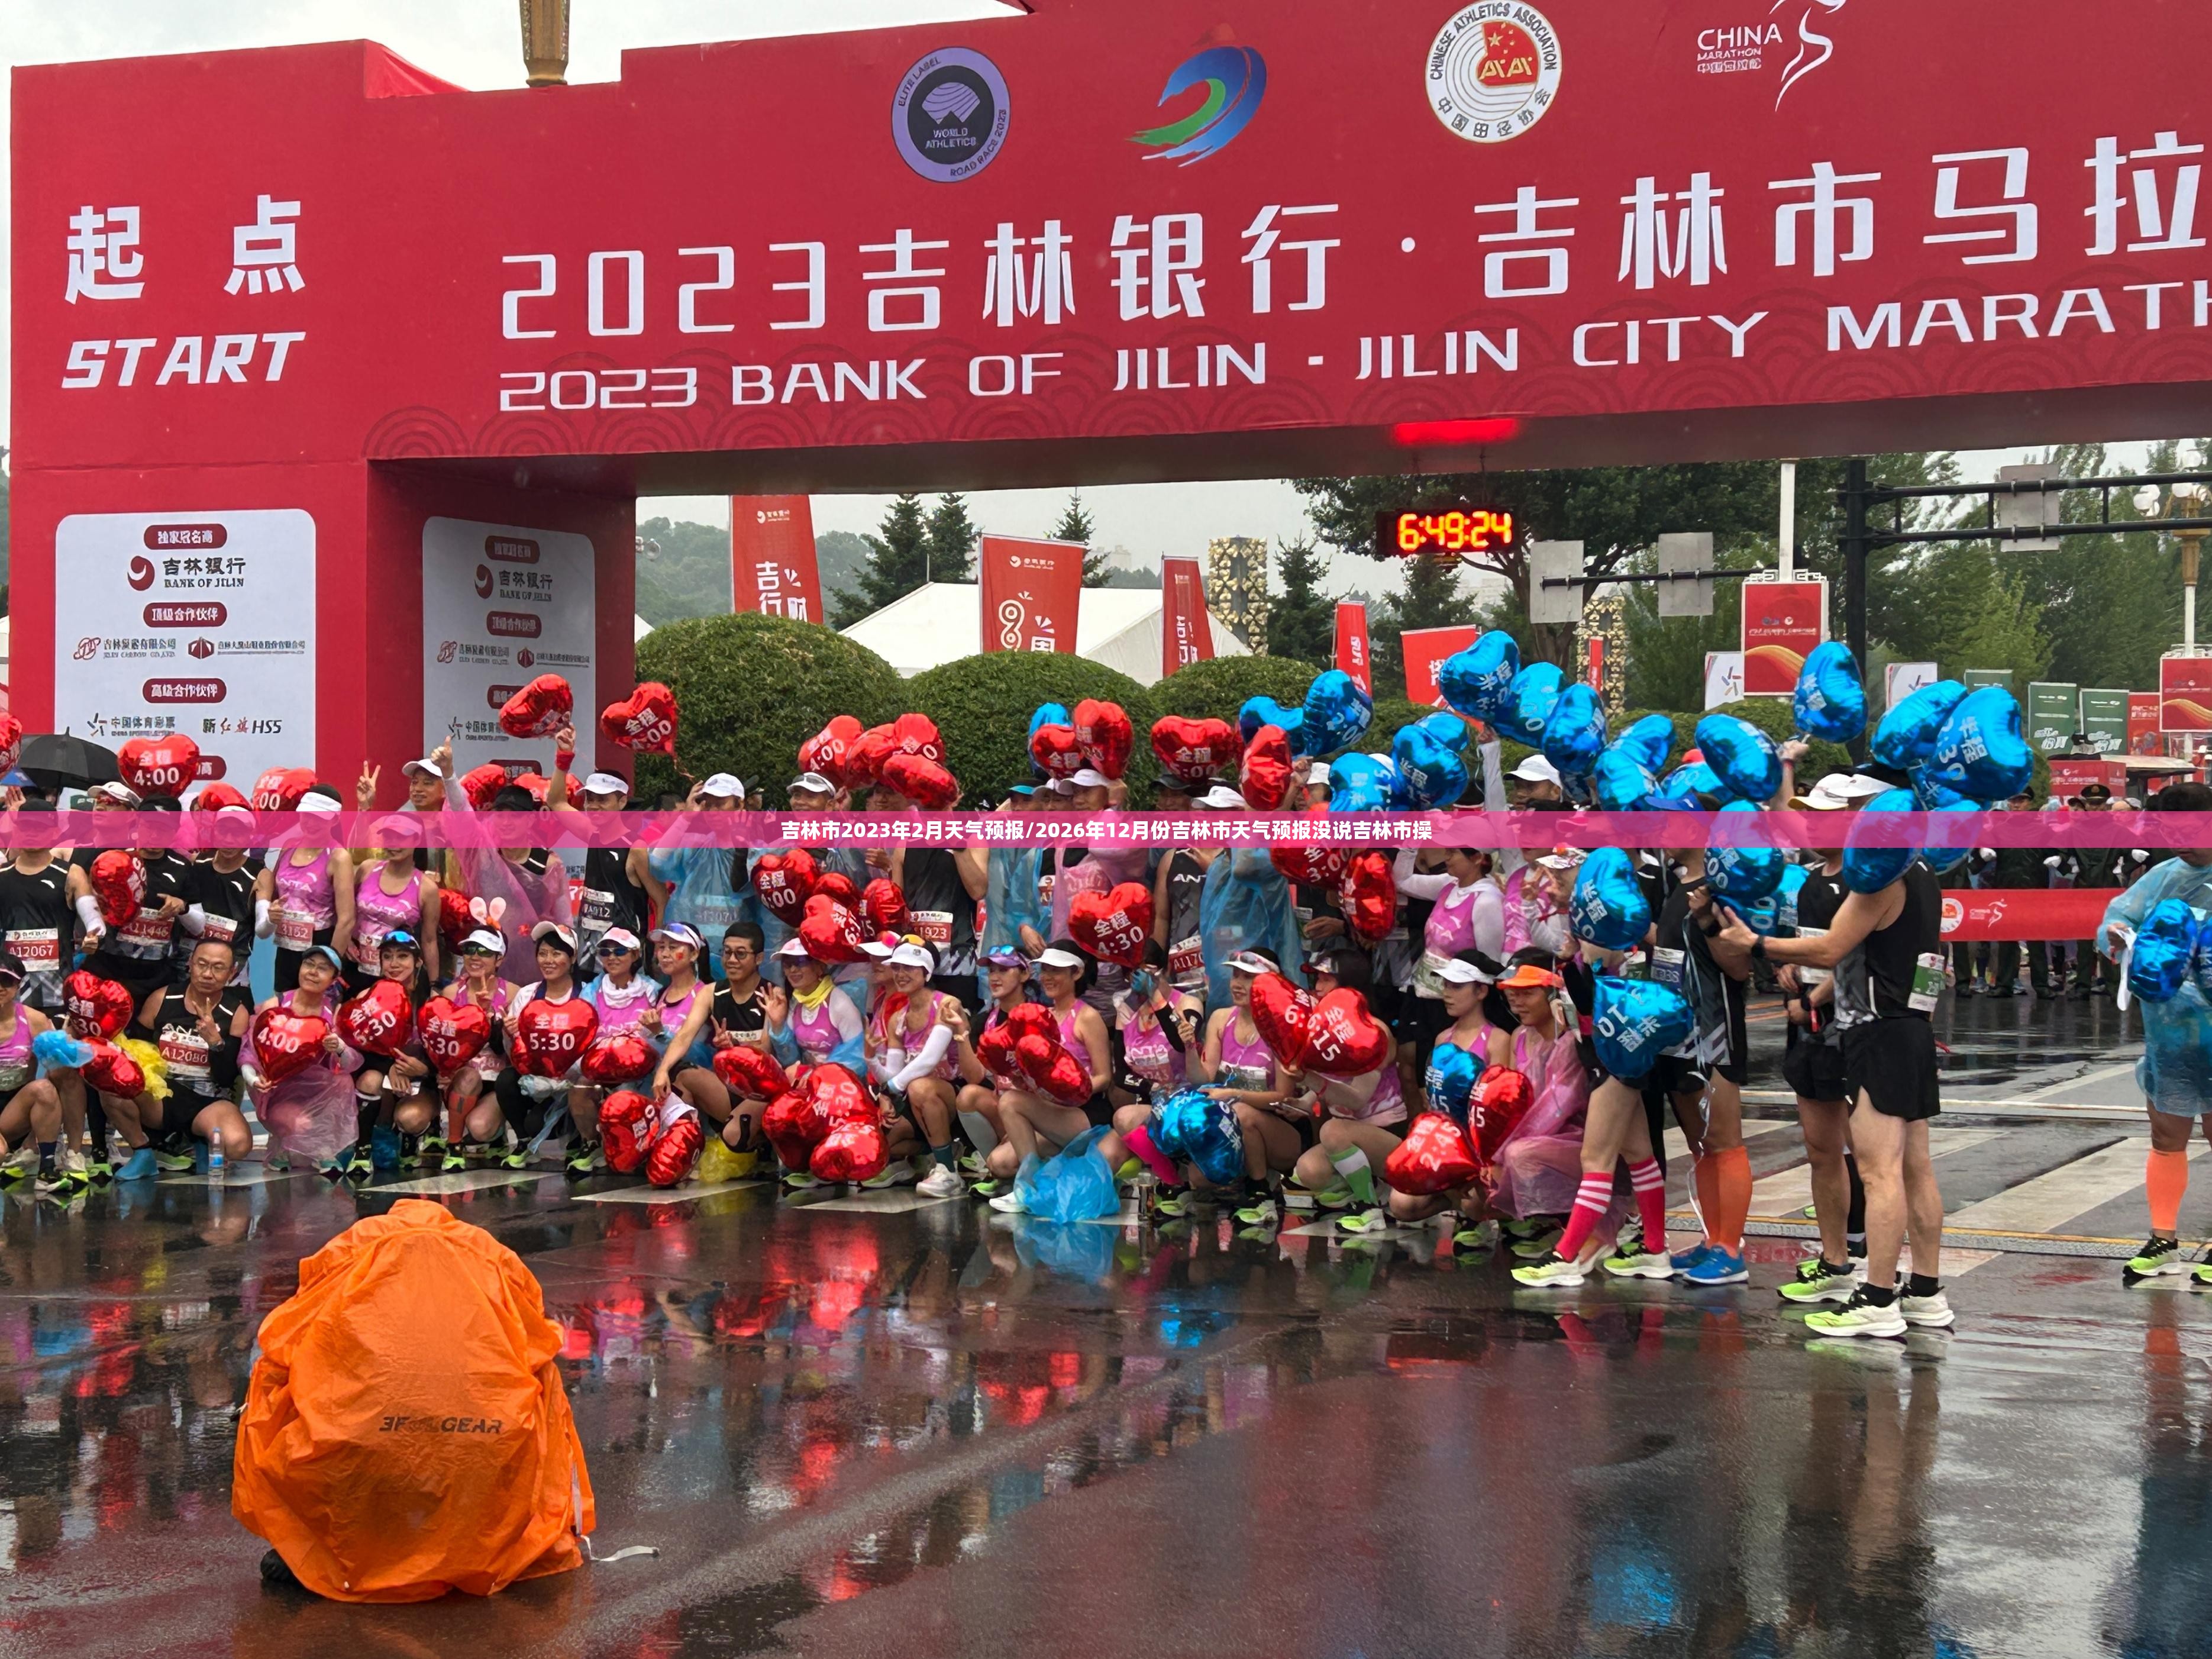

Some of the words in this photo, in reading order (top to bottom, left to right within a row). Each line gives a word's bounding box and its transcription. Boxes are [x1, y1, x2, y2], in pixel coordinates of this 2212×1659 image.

[1430, 30, 1456, 80] CHINESE
[1453, 2, 1511, 33] ATHLETICS
[1512, 7, 1557, 71] ASSOCIATION
[1697, 22, 1784, 51] CHINA
[1696, 47, 1762, 62] MARATHON
[914, 57, 942, 80] LABEL
[950, 161, 977, 176] ROAD
[977, 138, 998, 164] RACE
[64, 194, 306, 305] 起点
[61, 331, 306, 389] START
[499, 367, 697, 411] 2023
[731, 358, 927, 406] BANK
[968, 352, 1064, 396] OF
[1112, 342, 1266, 391] JILIN
[1355, 328, 1518, 380] JILIN
[1572, 311, 1770, 367] CITY
[1398, 510, 1513, 551] 6:49:24
[163, 557, 246, 576] 吉林银行
[164, 579, 195, 588] BANK
[198, 579, 212, 588] OF
[215, 577, 244, 588] JILIN
[251, 719, 282, 734] HS5
[134, 767, 180, 786] 4:00
[1094, 911, 1131, 938] 全程
[1097, 925, 1145, 956] 4:30
[352, 1010, 396, 1046] 5:30
[535, 1012, 570, 1030] 全程
[256, 1027, 299, 1054] 4:00
[529, 1032, 575, 1051] 5:30
[1306, 1012, 1341, 1062] 6:15
[161, 1046, 208, 1064] A12080
[440, 1416, 502, 1434] GEAR
